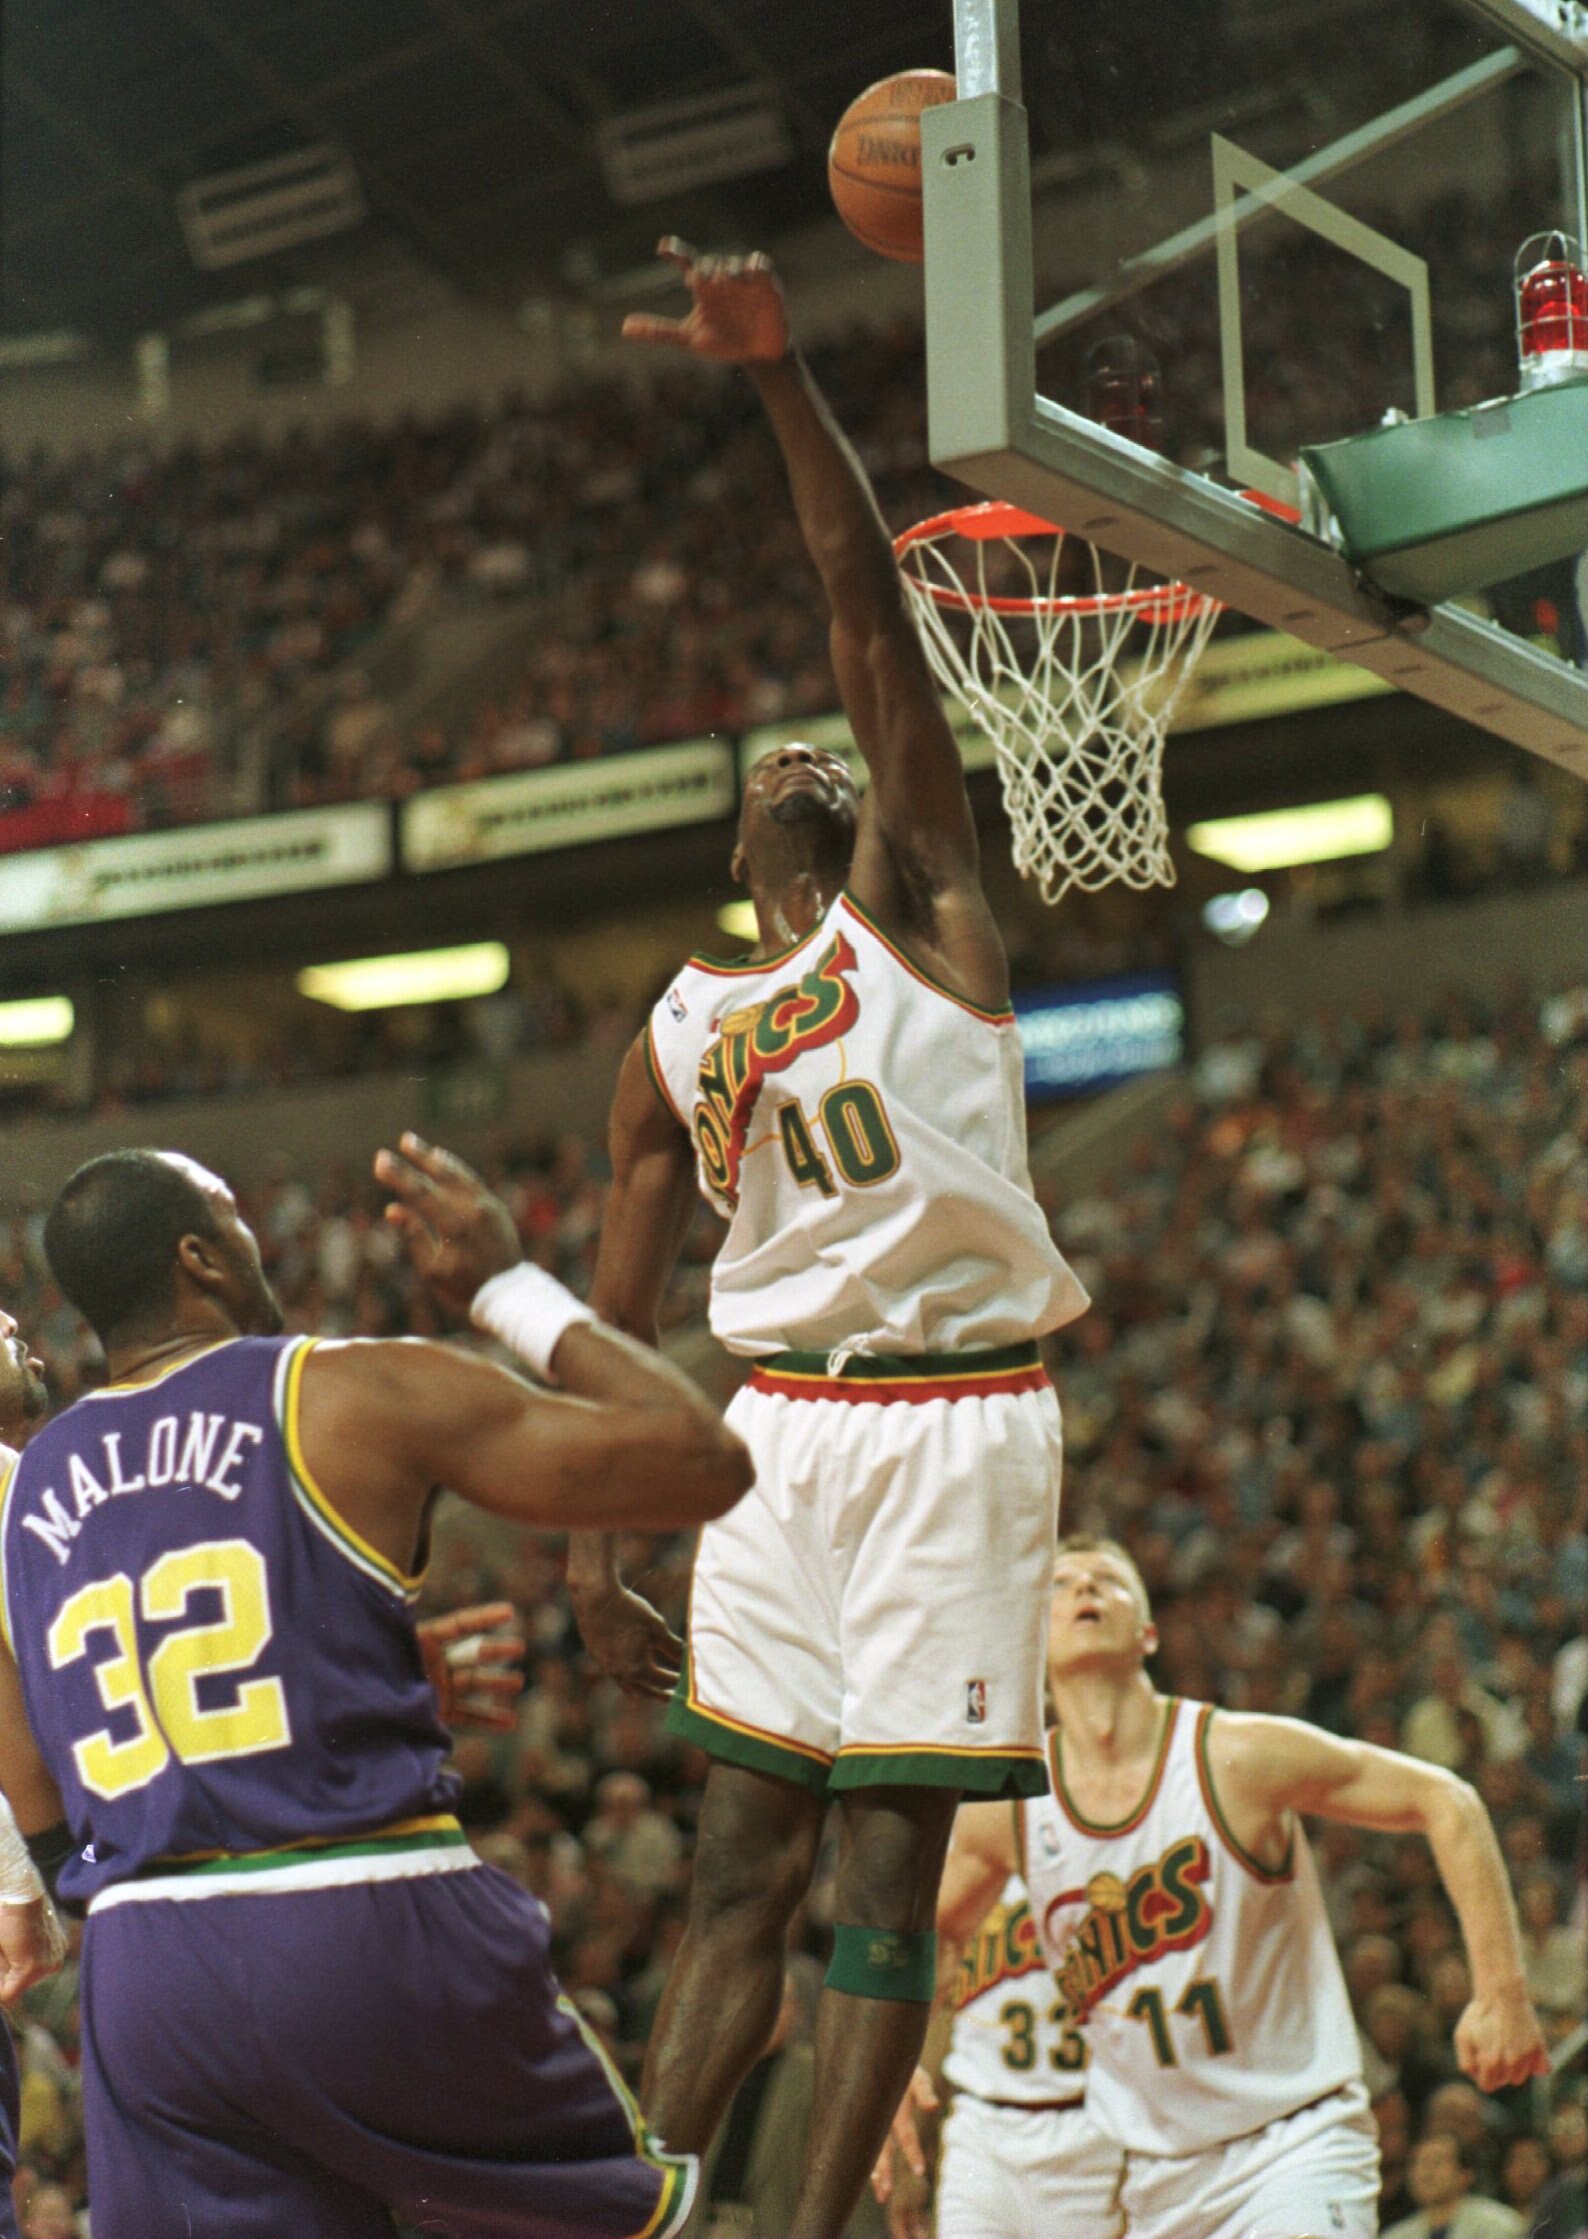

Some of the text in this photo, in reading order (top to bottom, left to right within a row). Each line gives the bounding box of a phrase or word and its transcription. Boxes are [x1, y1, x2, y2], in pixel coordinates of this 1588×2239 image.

[694, 931, 860, 1212] ONICS
[775, 1079, 901, 1200] 40
[21, 1411, 264, 1566] MALONE
[47, 1538, 293, 1801] 32
[1000, 2000, 1092, 2072] 33
[1126, 1975, 1234, 2069] 11
